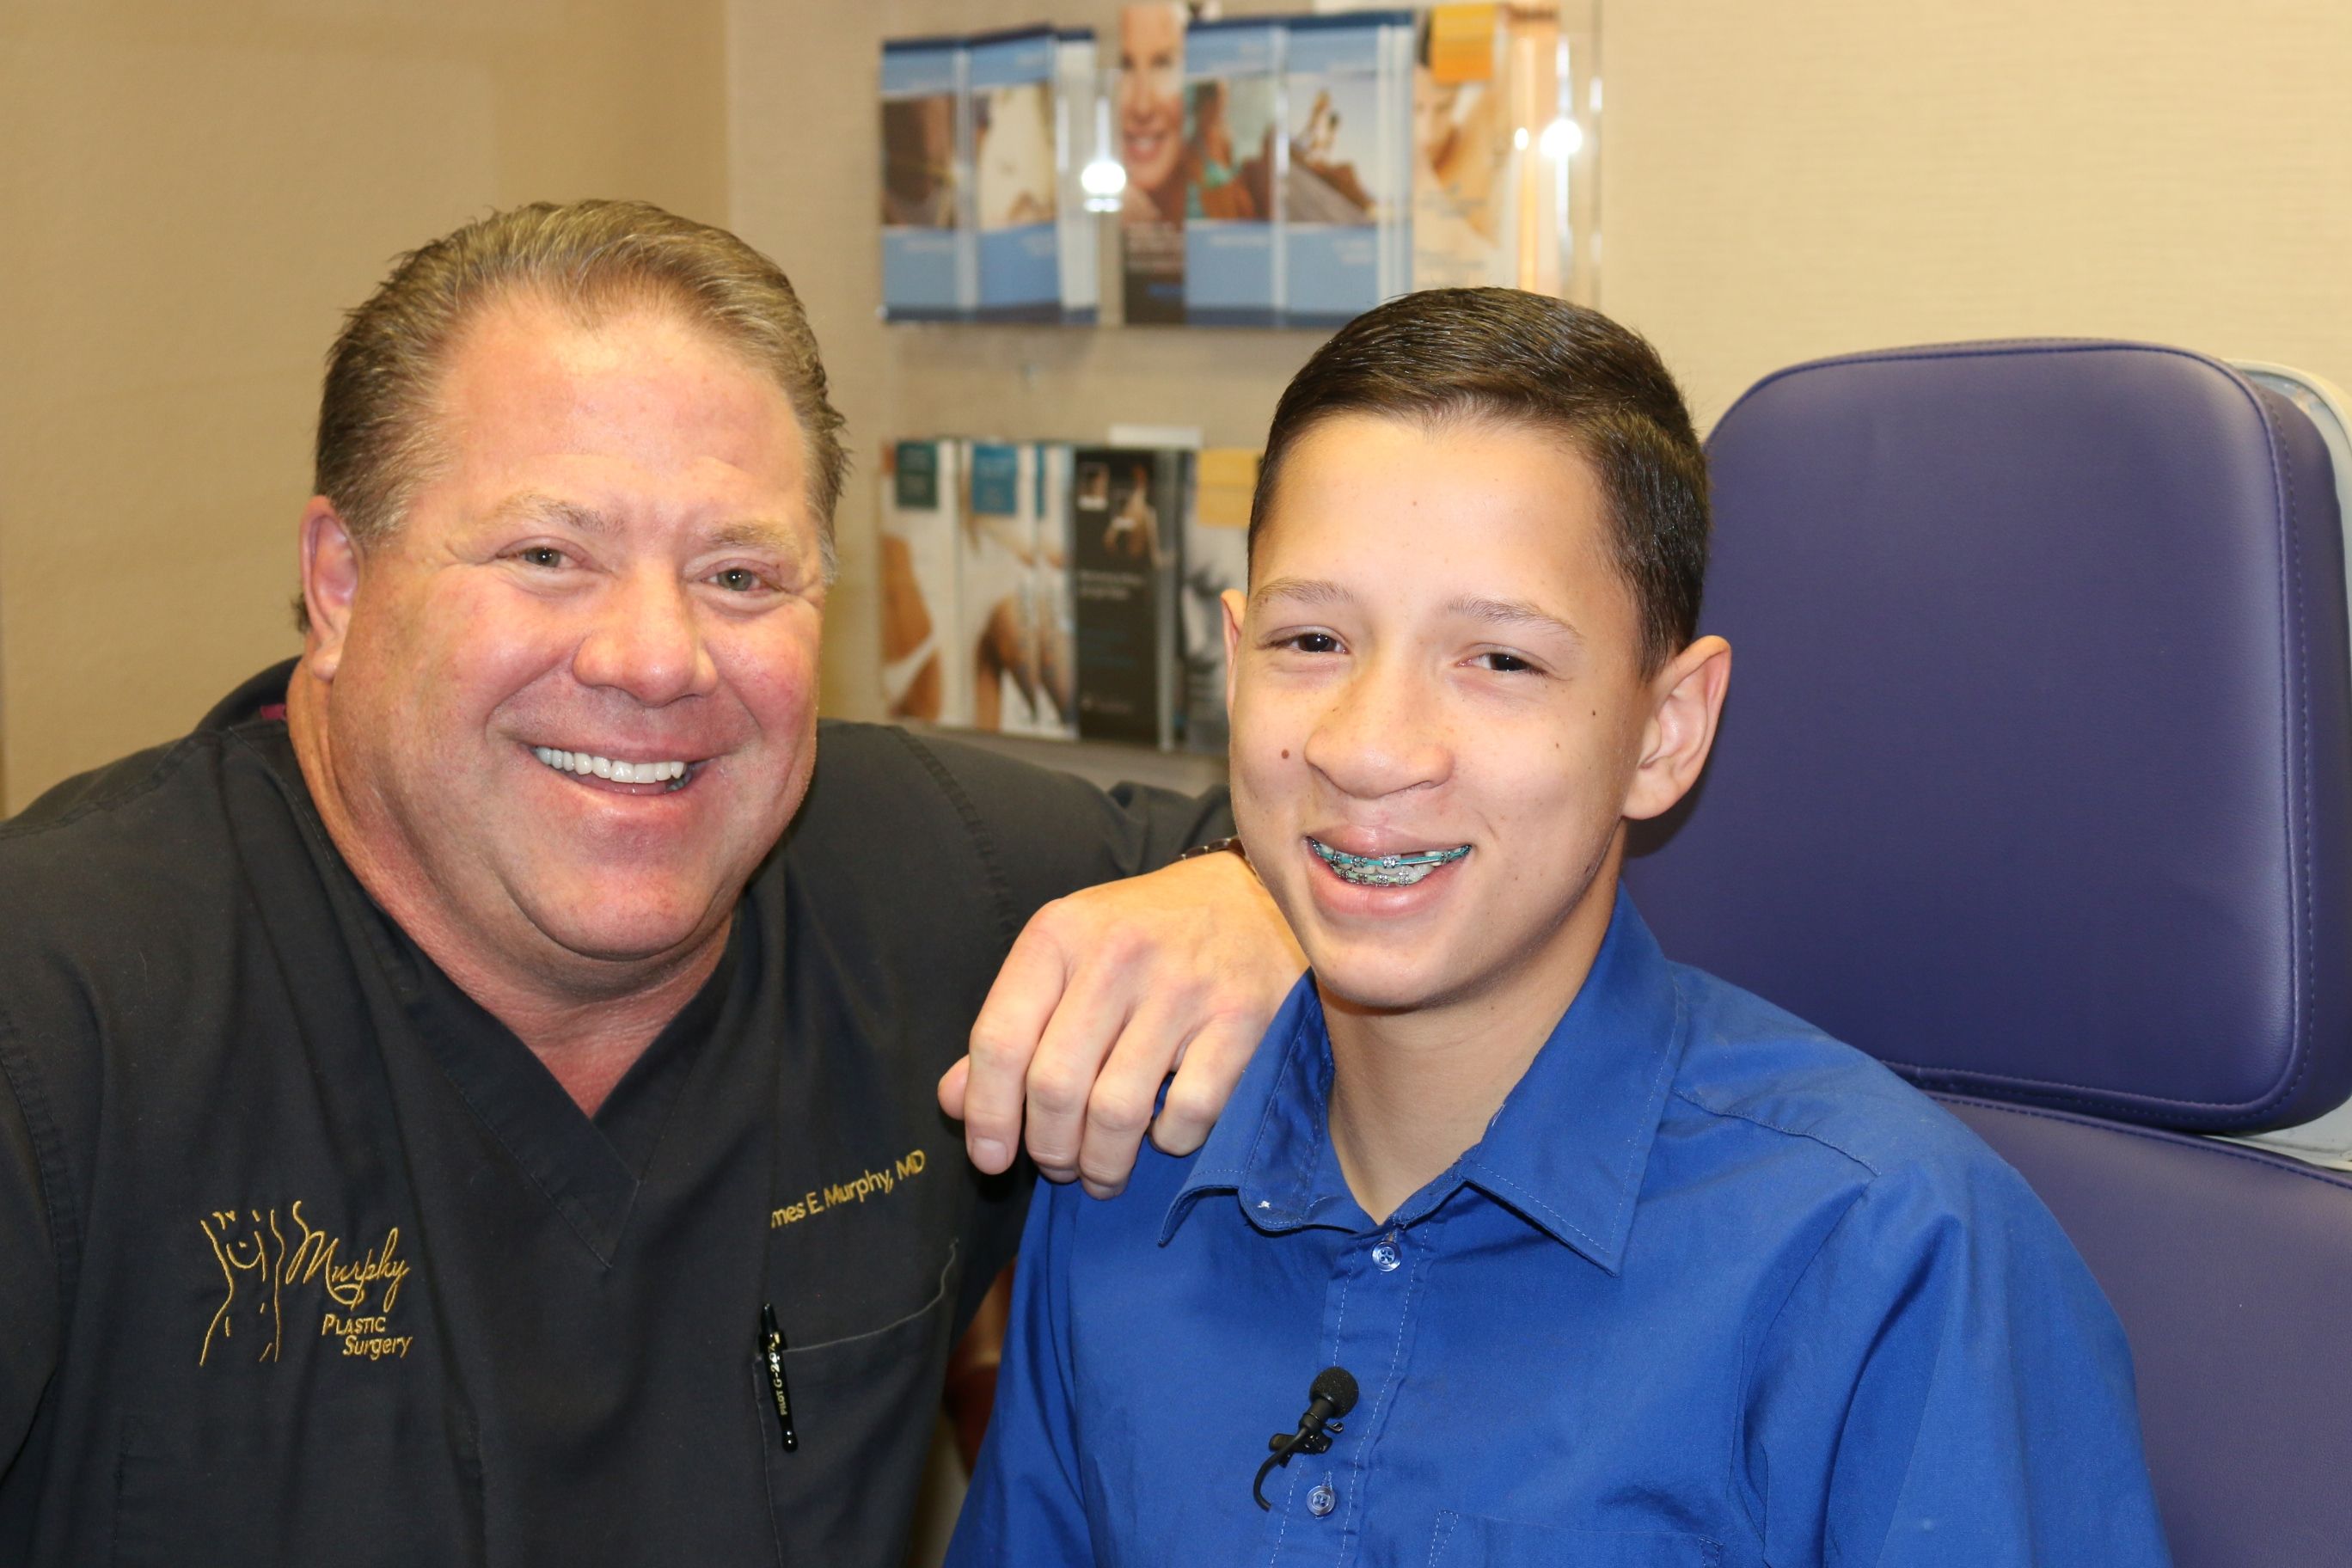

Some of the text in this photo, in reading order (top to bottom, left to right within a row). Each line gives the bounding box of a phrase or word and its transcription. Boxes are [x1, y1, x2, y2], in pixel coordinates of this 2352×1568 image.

[771, 1149, 926, 1228] mes E. Murphy, MD
[285, 1200, 411, 1313] Murphy
[343, 1335, 413, 1361] Surgery
[770, 1363, 782, 1388] G-2
[775, 1389, 787, 1416] PILOT
